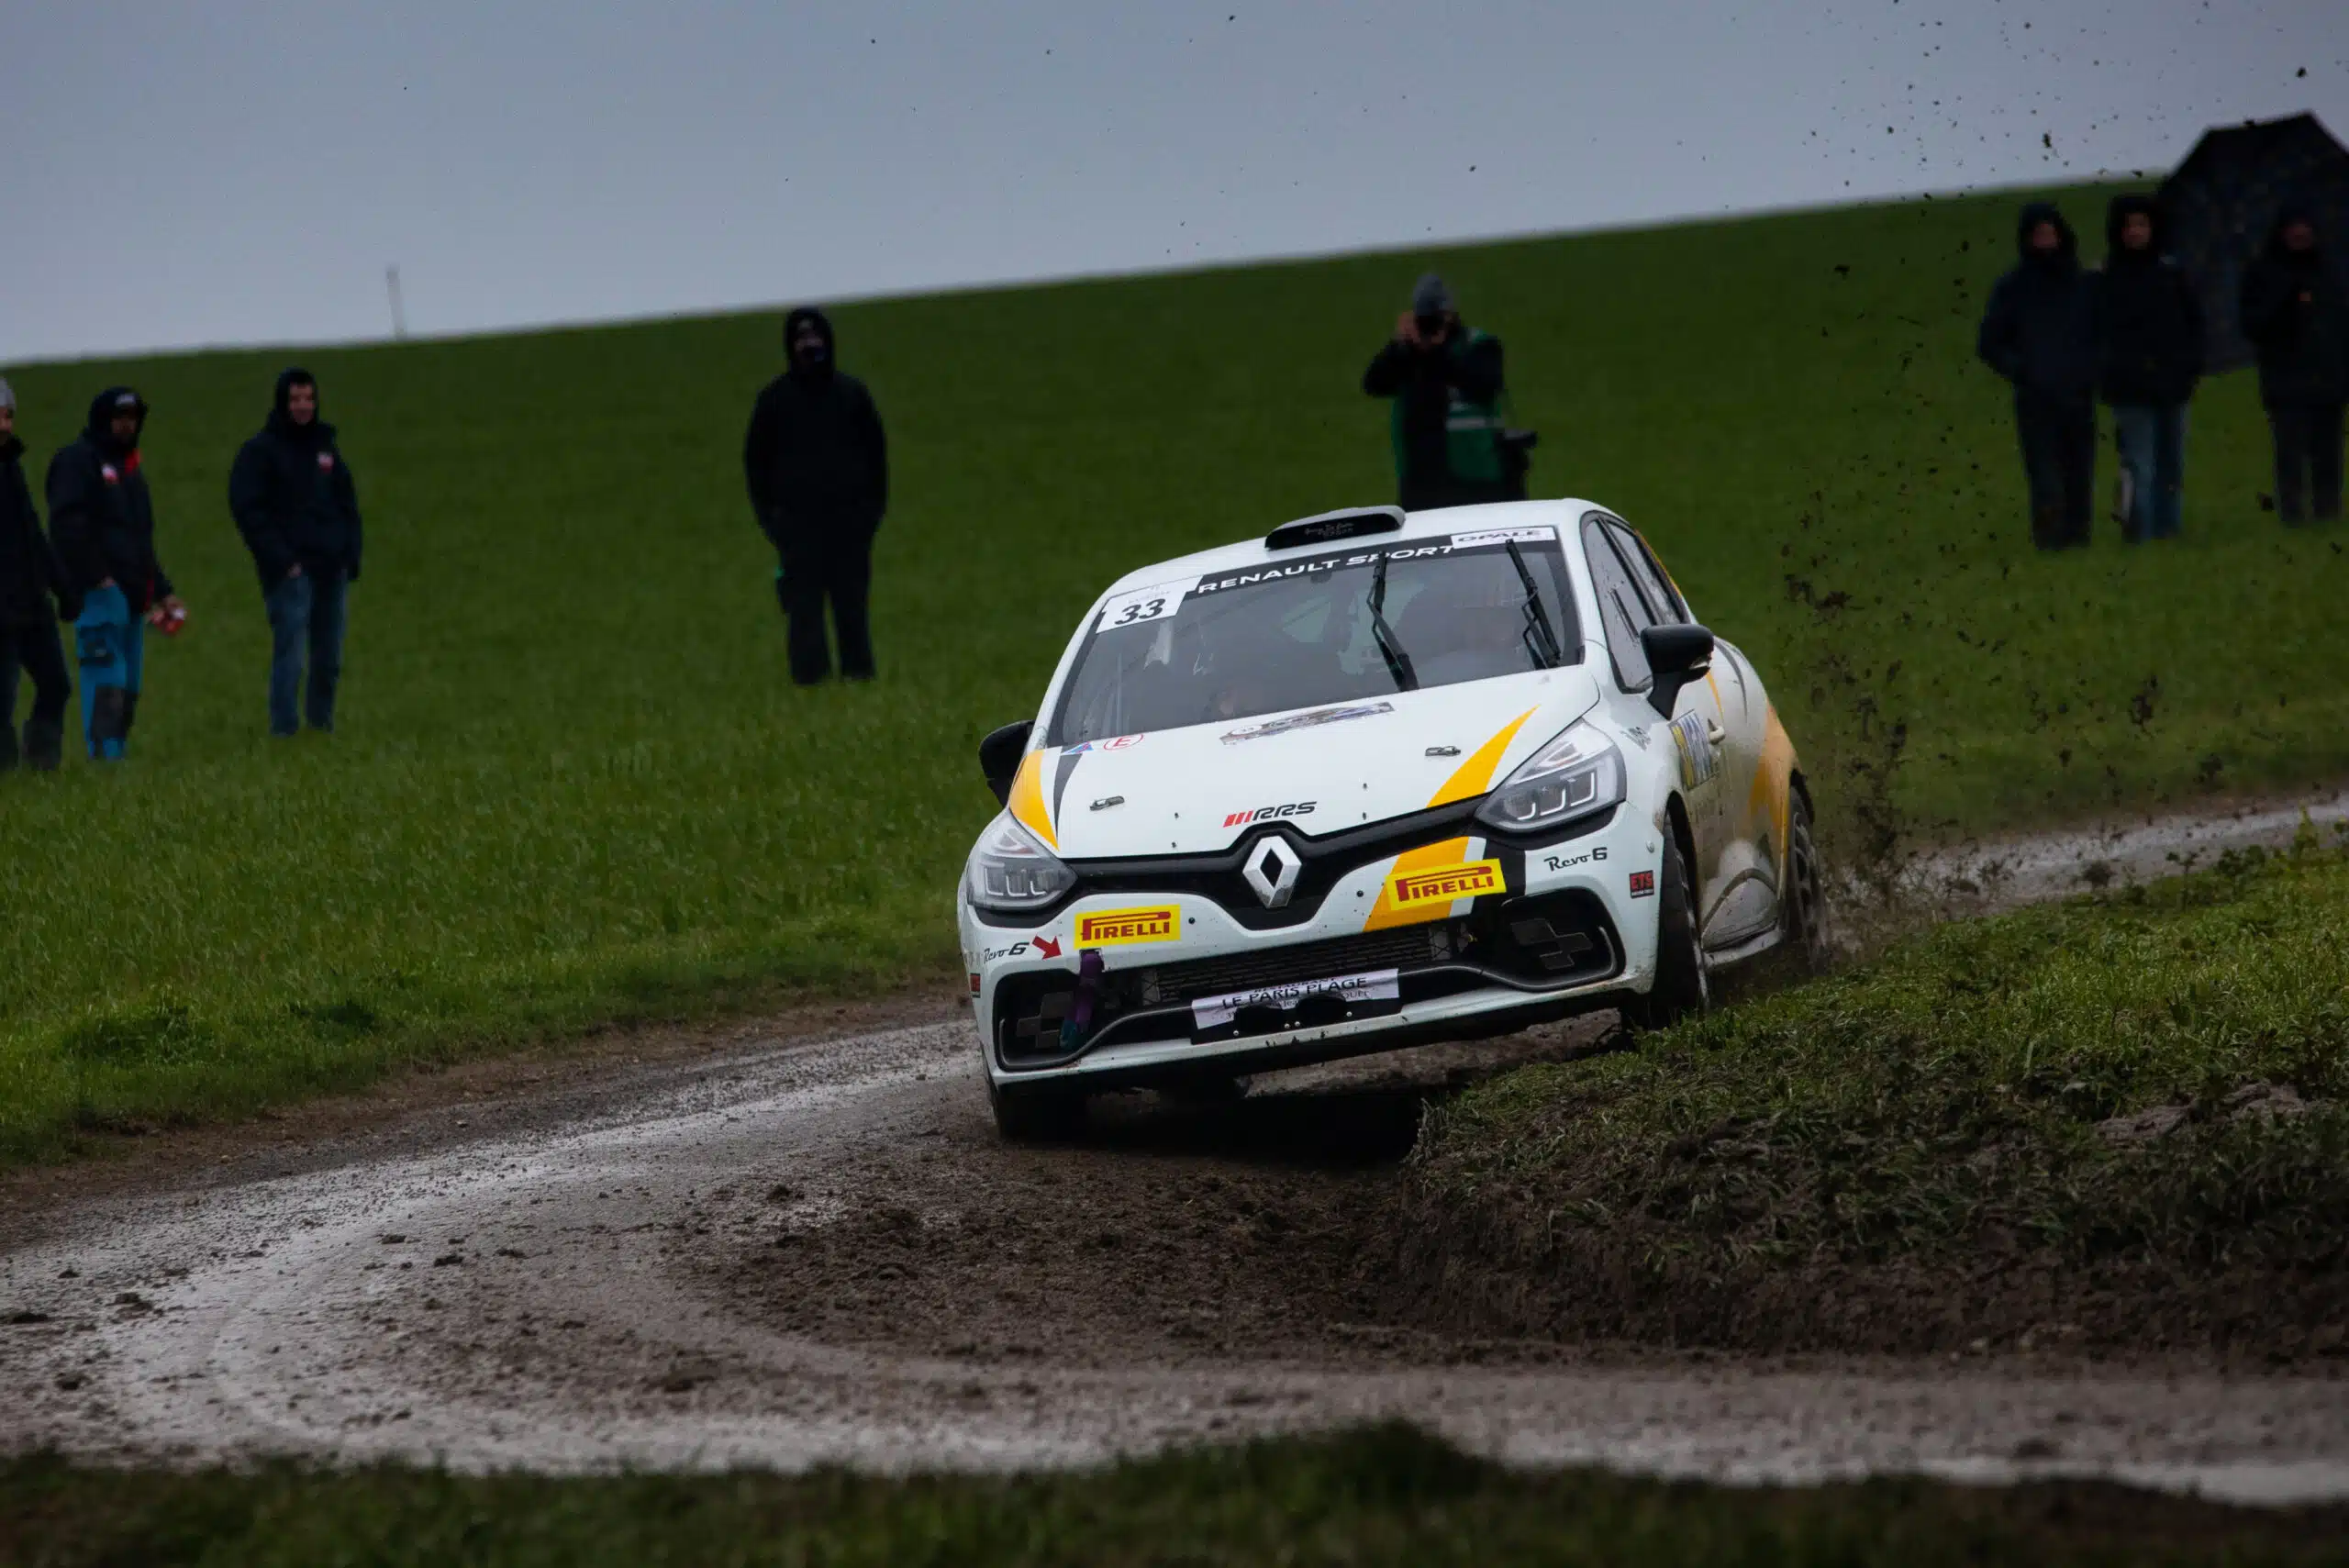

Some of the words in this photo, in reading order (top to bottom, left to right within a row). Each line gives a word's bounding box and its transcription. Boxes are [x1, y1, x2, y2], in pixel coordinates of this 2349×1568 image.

[1457, 529, 1542, 542] OPALE
[1197, 559, 1341, 595] RENAULT
[1345, 545, 1454, 566] SPORT
[1114, 598, 1166, 626] 33
[1252, 801, 1318, 821] RRS
[1394, 865, 1495, 902] PIRELLI
[1630, 873, 1653, 890] ETS
[1081, 911, 1172, 940] PIRELLI
[1221, 995, 1243, 1009] LE
[1248, 987, 1300, 1004] PARIS
[1306, 977, 1367, 995] PLAGE
